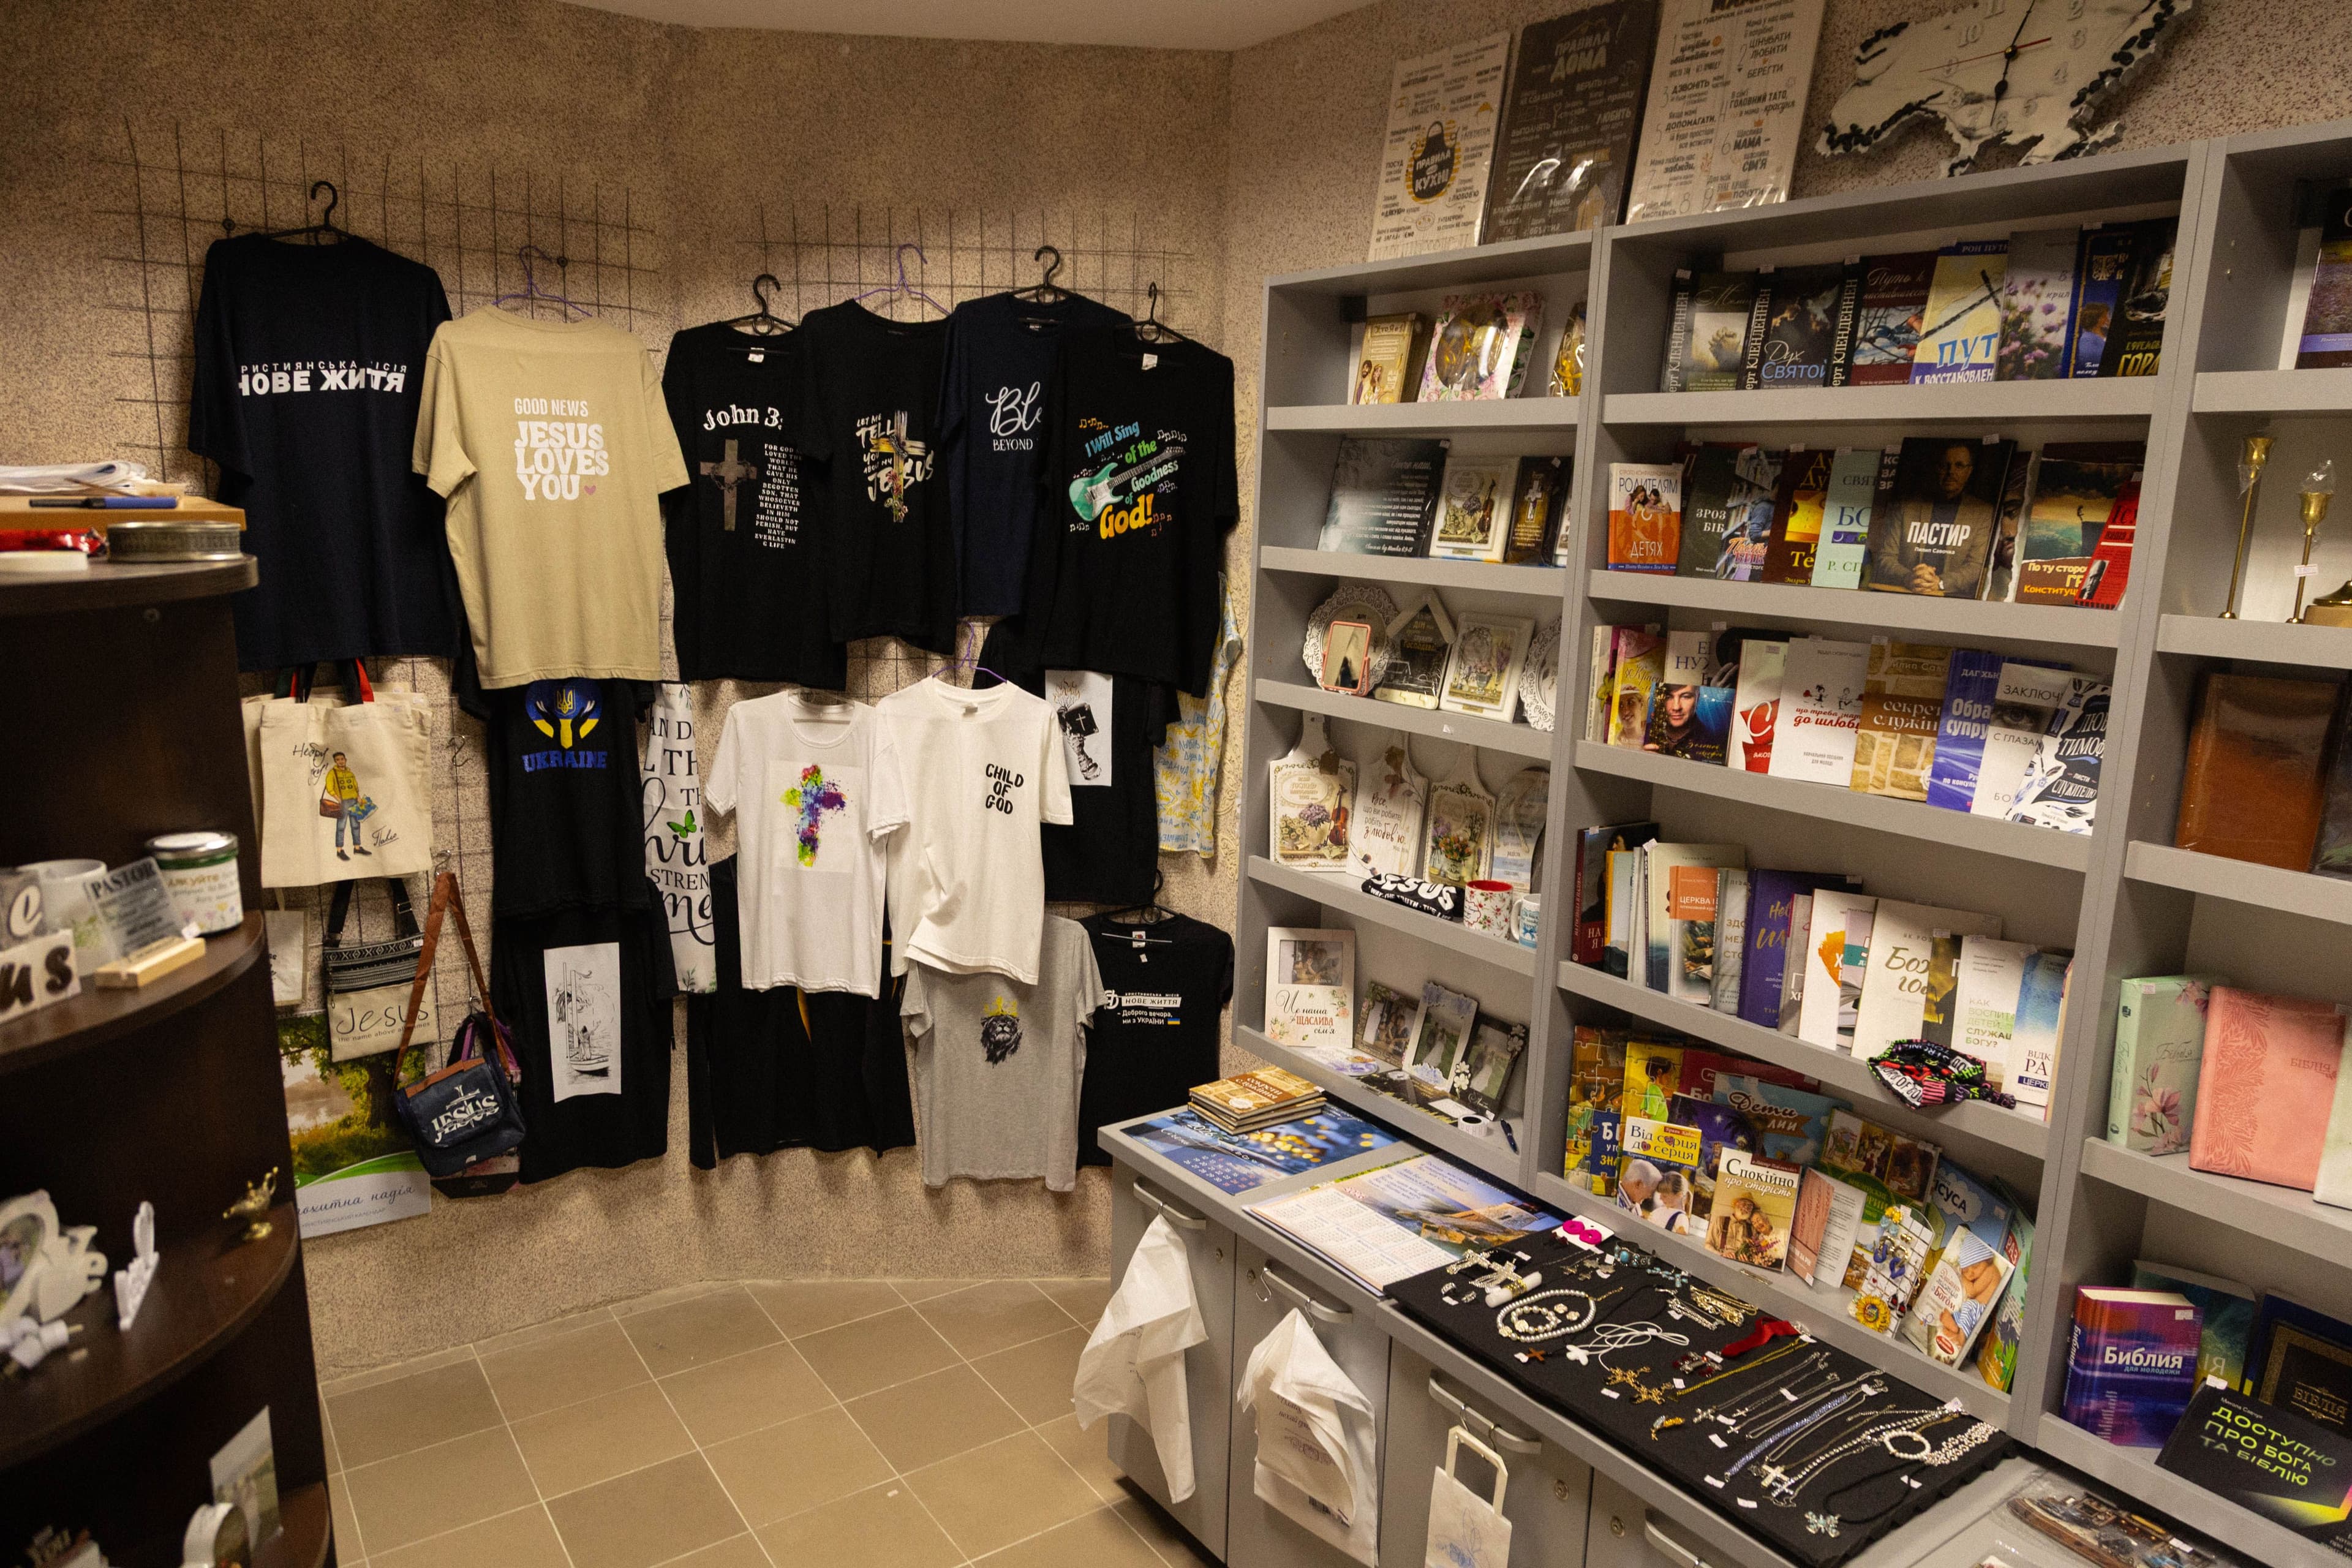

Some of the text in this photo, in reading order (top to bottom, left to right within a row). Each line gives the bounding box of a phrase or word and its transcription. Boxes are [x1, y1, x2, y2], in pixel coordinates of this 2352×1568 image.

[1749, 31, 1790, 48] ЦІНУВАТИ
[1751, 44, 1787, 59] ЛЮБИТИ
[1550, 45, 1607, 83] ДОМА
[1747, 64, 1784, 78] БЕРЕГТИ
[1733, 137, 1762, 151] МАМА
[1415, 149, 1451, 170] ПРАВИЛА
[1415, 170, 1449, 193] КУХНІ
[1866, 268, 1912, 292] Путь
[1764, 340, 1806, 367] Дух
[1937, 333, 1999, 369] ПУТ
[241, 361, 407, 373] РИСТИЯНСЬКА ІСІЯ
[1924, 369, 1994, 385] ВОССТАНОВЛЕН
[514, 398, 589, 418] GOOD NEWS
[703, 404, 759, 430] John
[856, 413, 882, 427] LET ME
[514, 421, 605, 451] JESUS
[856, 419, 895, 449] TELL
[1085, 421, 1140, 458] I Will Sing
[993, 439, 1033, 451] BEYOND
[1125, 440, 1157, 464] of the
[514, 447, 609, 477] LOVES
[764, 450, 787, 459] LOVED
[863, 451, 880, 466] YOU
[881, 457, 892, 466] MY
[767, 464, 786, 472] THAT
[867, 450, 935, 502] JESUS
[1131, 460, 1178, 492] Goodness
[518, 474, 581, 501] YOU
[763, 482, 799, 493] BEGOTTEN
[1619, 477, 1678, 494] РОДИТЕЛЯМ
[758, 495, 800, 507] WHOSOEVER
[780, 491, 799, 500] THAT
[1125, 492, 1134, 505] of
[760, 502, 798, 513] BELIEVETH
[1695, 508, 1727, 521] ЗРОЗ
[756, 514, 783, 523] SHOULD
[1099, 493, 1155, 540] God!
[1703, 522, 1725, 533] БІБ
[1907, 521, 1971, 547] ПАСТИР
[755, 533, 796, 545] EVERLASTIN
[1630, 540, 1663, 559] ДЕТЯХ
[1827, 561, 1837, 571] Р.
[2028, 562, 2054, 574] По ту
[1961, 668, 1978, 677] ДАГ
[1796, 707, 1838, 718] що треба
[1952, 698, 1991, 719] Обра
[1793, 714, 1812, 728] до
[1946, 718, 1989, 741] супру
[1993, 733, 2000, 741] С
[522, 750, 608, 773] UKRAINE
[986, 763, 1024, 788] CHILD
[993, 781, 1012, 797] OF
[2051, 778, 2098, 800] СЛУЖИТЕЛЮ
[985, 793, 1014, 815] GOD
[1372, 792, 1388, 808] Все,
[1364, 816, 1382, 827] робіть
[1363, 826, 1370, 839] з
[91, 861, 157, 899] PASTOR
[650, 868, 710, 891] STREN
[1371, 873, 1457, 911] JESUS
[1679, 896, 1710, 906] ЦЕРКВА
[1588, 927, 1602, 938] НА
[1969, 997, 1990, 1007] КАК
[1137, 1017, 1164, 1025] УКРАЇНИ
[1296, 1015, 1334, 1027] ЩАСЛИВА
[374, 1029, 396, 1038] above
[1313, 1027, 1336, 1036] сім'я
[1965, 1036, 1999, 1048] БОГУ?
[431, 1095, 500, 1144] JESUS
[1630, 1125, 1697, 1150] Від серця
[1653, 1145, 1694, 1161] серця
[1726, 1158, 1794, 1188] Спокійно
[1724, 1176, 1792, 1197] про старість
[371, 1186, 416, 1205] надія
[2104, 1346, 2184, 1370] Библия
[2124, 1365, 2181, 1376] для молодежи
[2292, 1385, 2348, 1419] БІБЛІЯ
[2212, 1405, 2337, 1468] ДОСТУПНО
[2204, 1420, 2313, 1473] ПРО БОГА
[2199, 1434, 2309, 1487] ТА БІБЛІЮ
